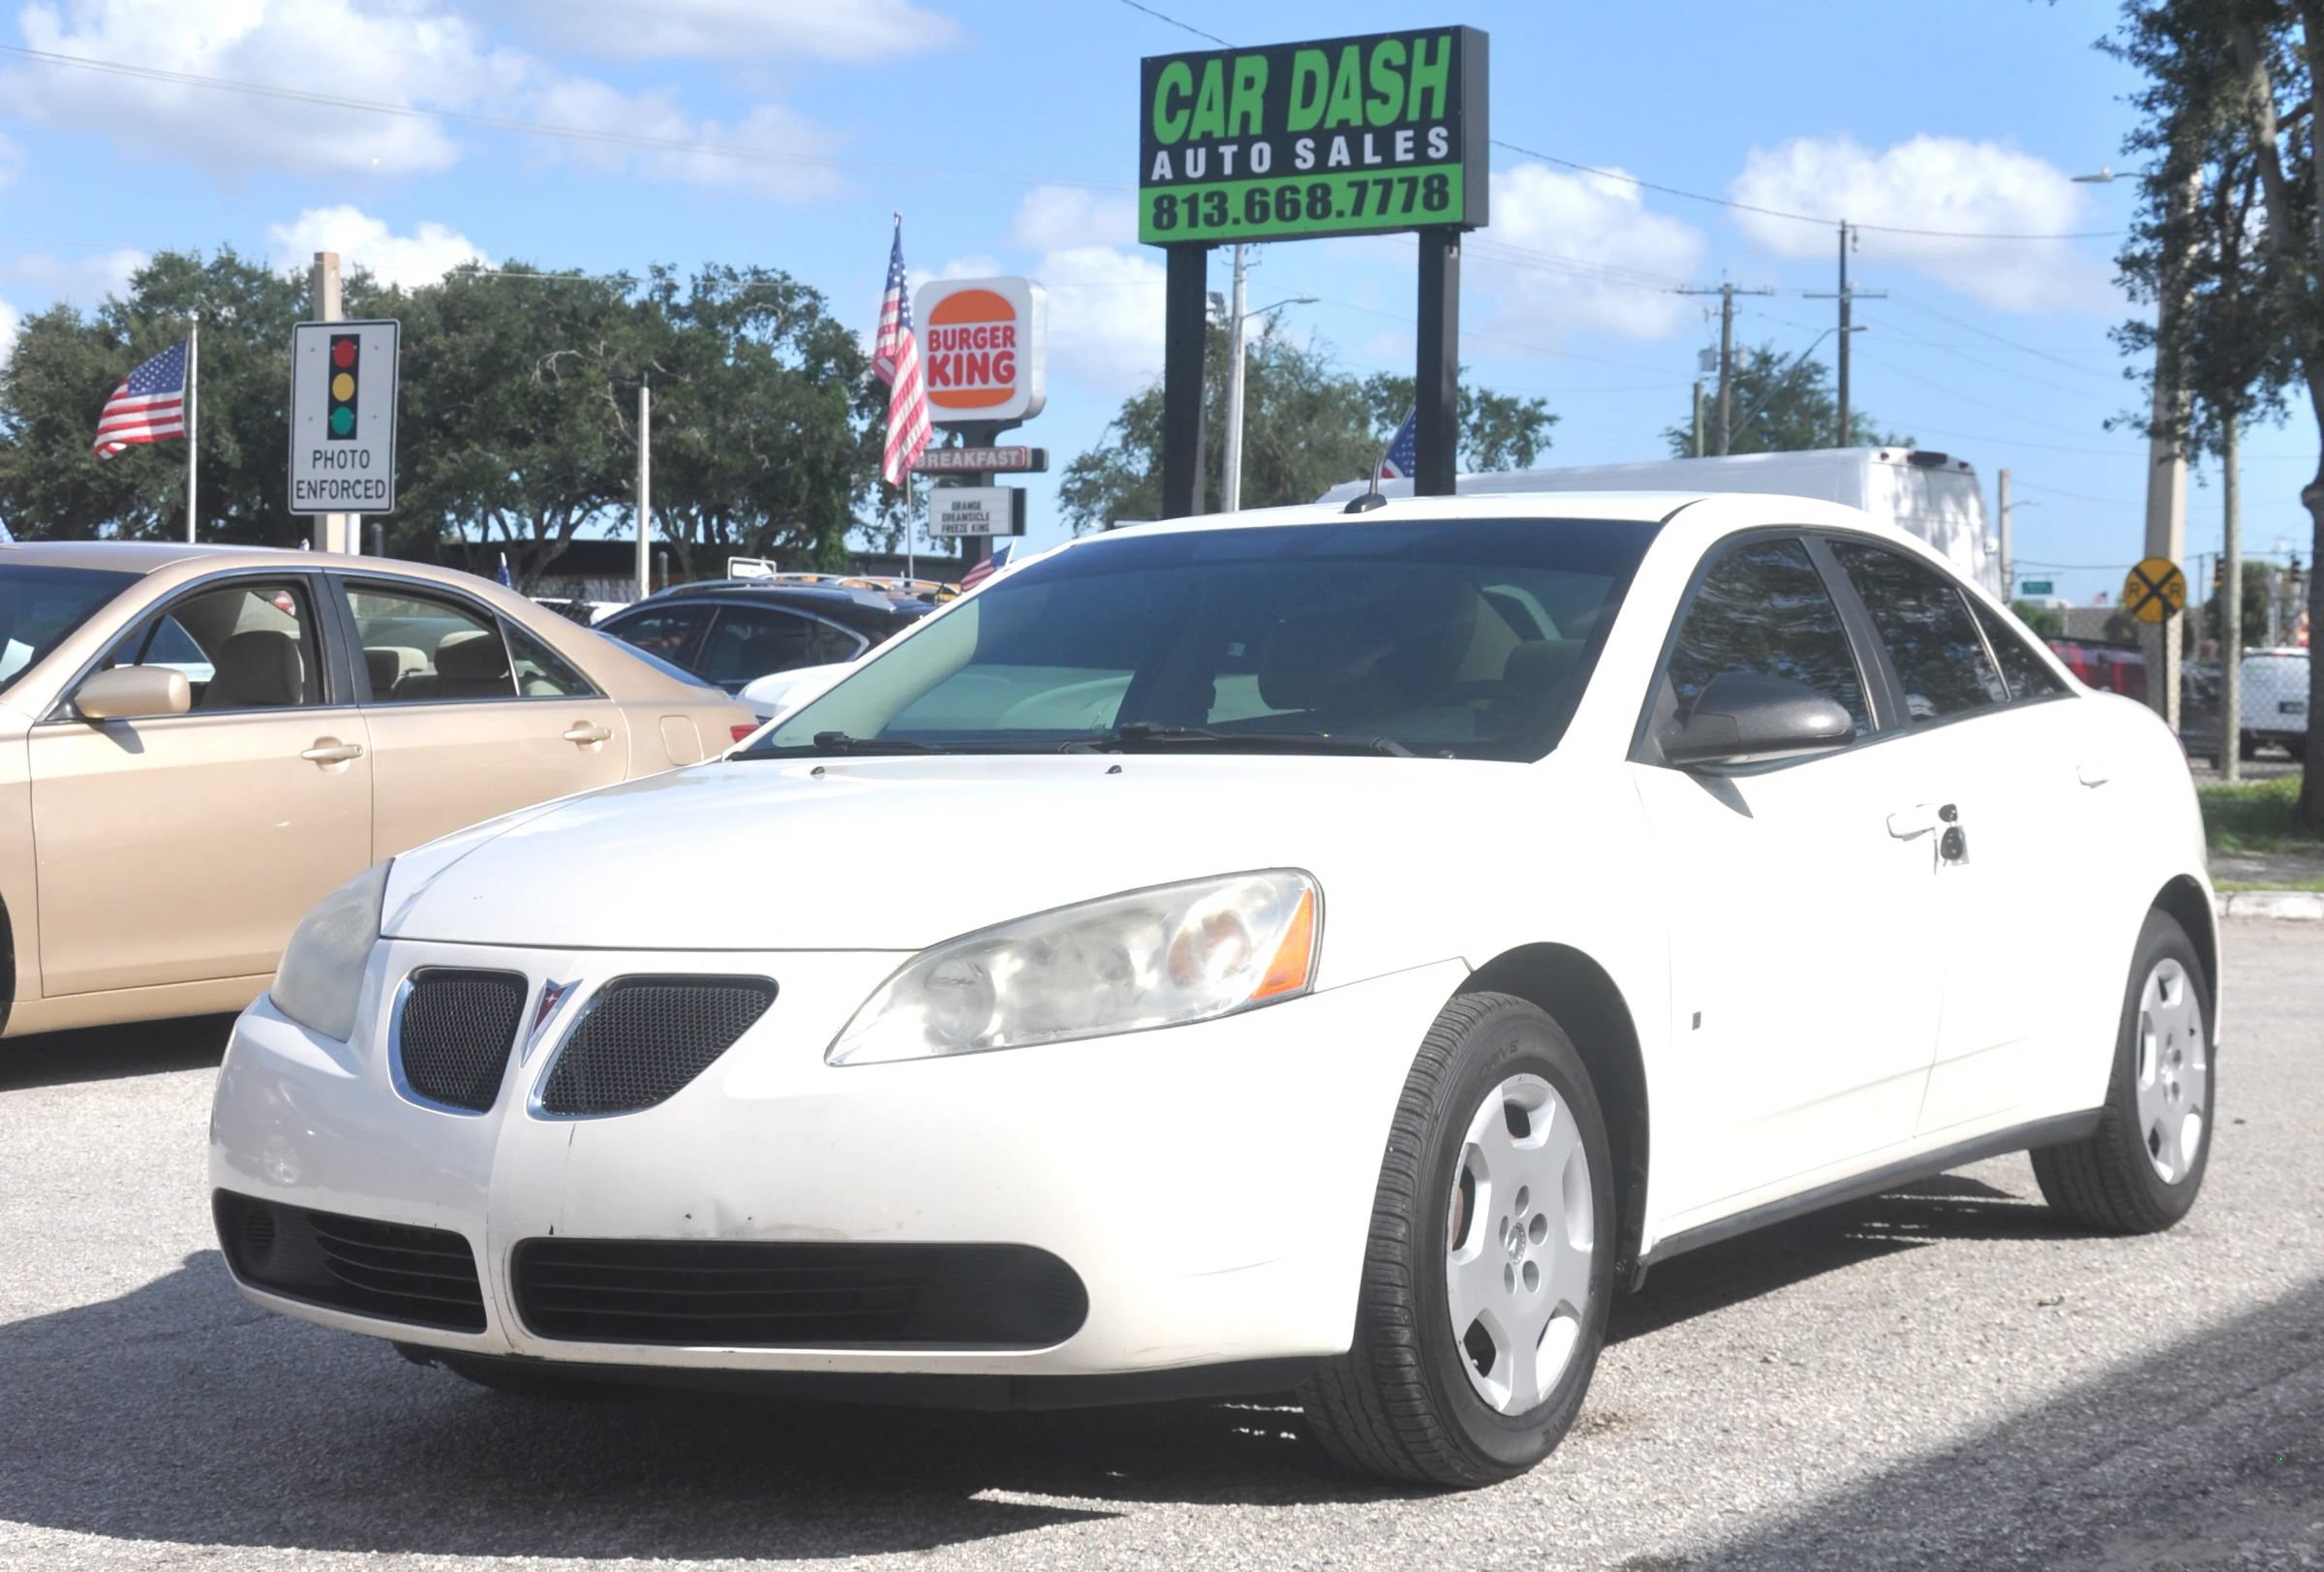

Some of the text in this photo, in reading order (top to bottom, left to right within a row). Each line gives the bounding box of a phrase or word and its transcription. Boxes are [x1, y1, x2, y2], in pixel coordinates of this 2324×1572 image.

[1152, 34, 1452, 145] CAR DASH
[1150, 126, 1450, 182] AUTO SALES
[1152, 173, 1450, 231] 813.668.7778
[928, 324, 1016, 353] BURGER
[928, 350, 1016, 387] KING
[312, 449, 371, 470] PHOTO
[295, 479, 386, 500] ENFORCED
[951, 501, 982, 511] ORANGE
[941, 523, 990, 534] FREEZE KING
